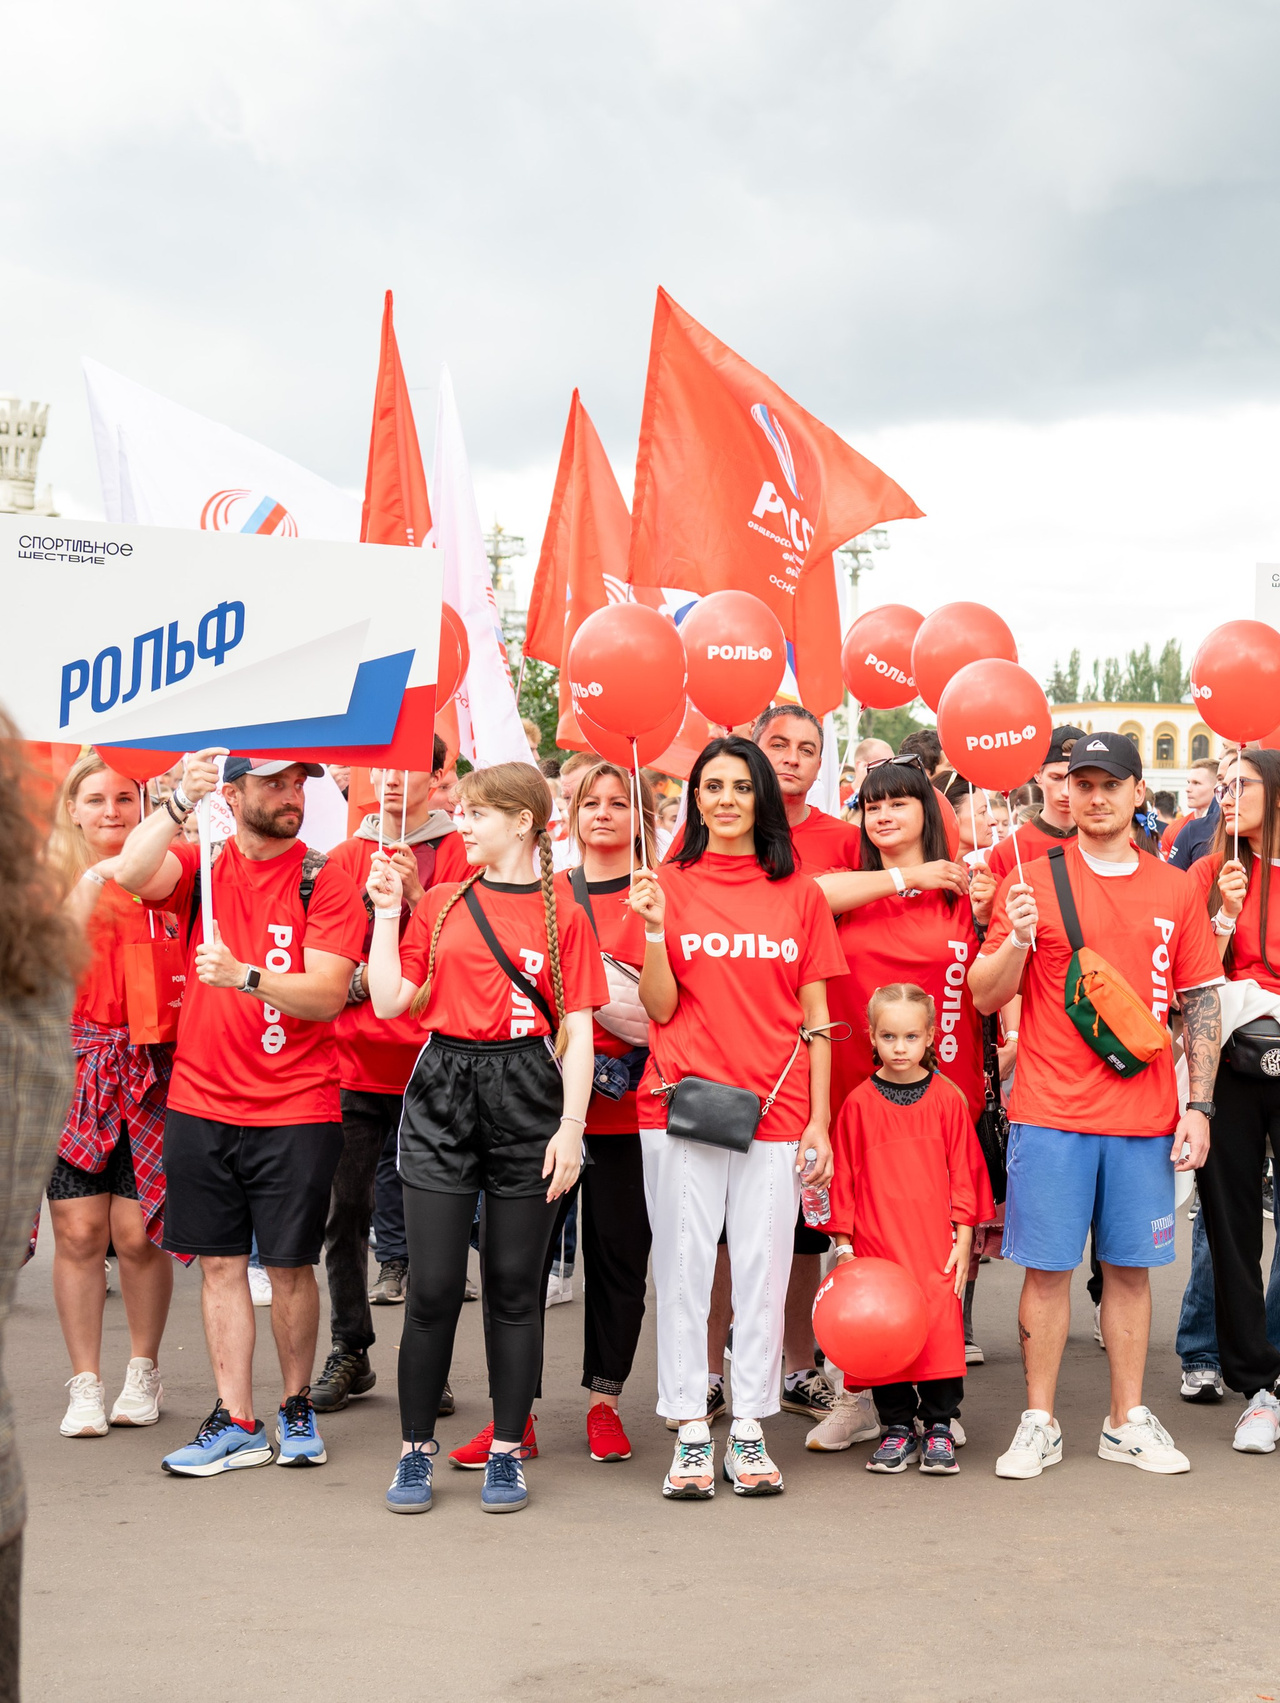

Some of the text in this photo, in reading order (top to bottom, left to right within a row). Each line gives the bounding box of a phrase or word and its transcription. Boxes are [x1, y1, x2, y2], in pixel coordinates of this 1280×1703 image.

[18, 549, 106, 565] ШЕСТВИЕ
[59, 600, 246, 729] РОЛЬФ
[707, 645, 773, 662] РОЛЬФ
[966, 724, 1038, 752] РОЛЬФ
[680, 932, 799, 964] РОЛЬФ
[1151, 917, 1175, 1023] РОЛЬ
[261, 923, 293, 1055] РОЬФ
[938, 940, 968, 1063] РОЛЬФ
